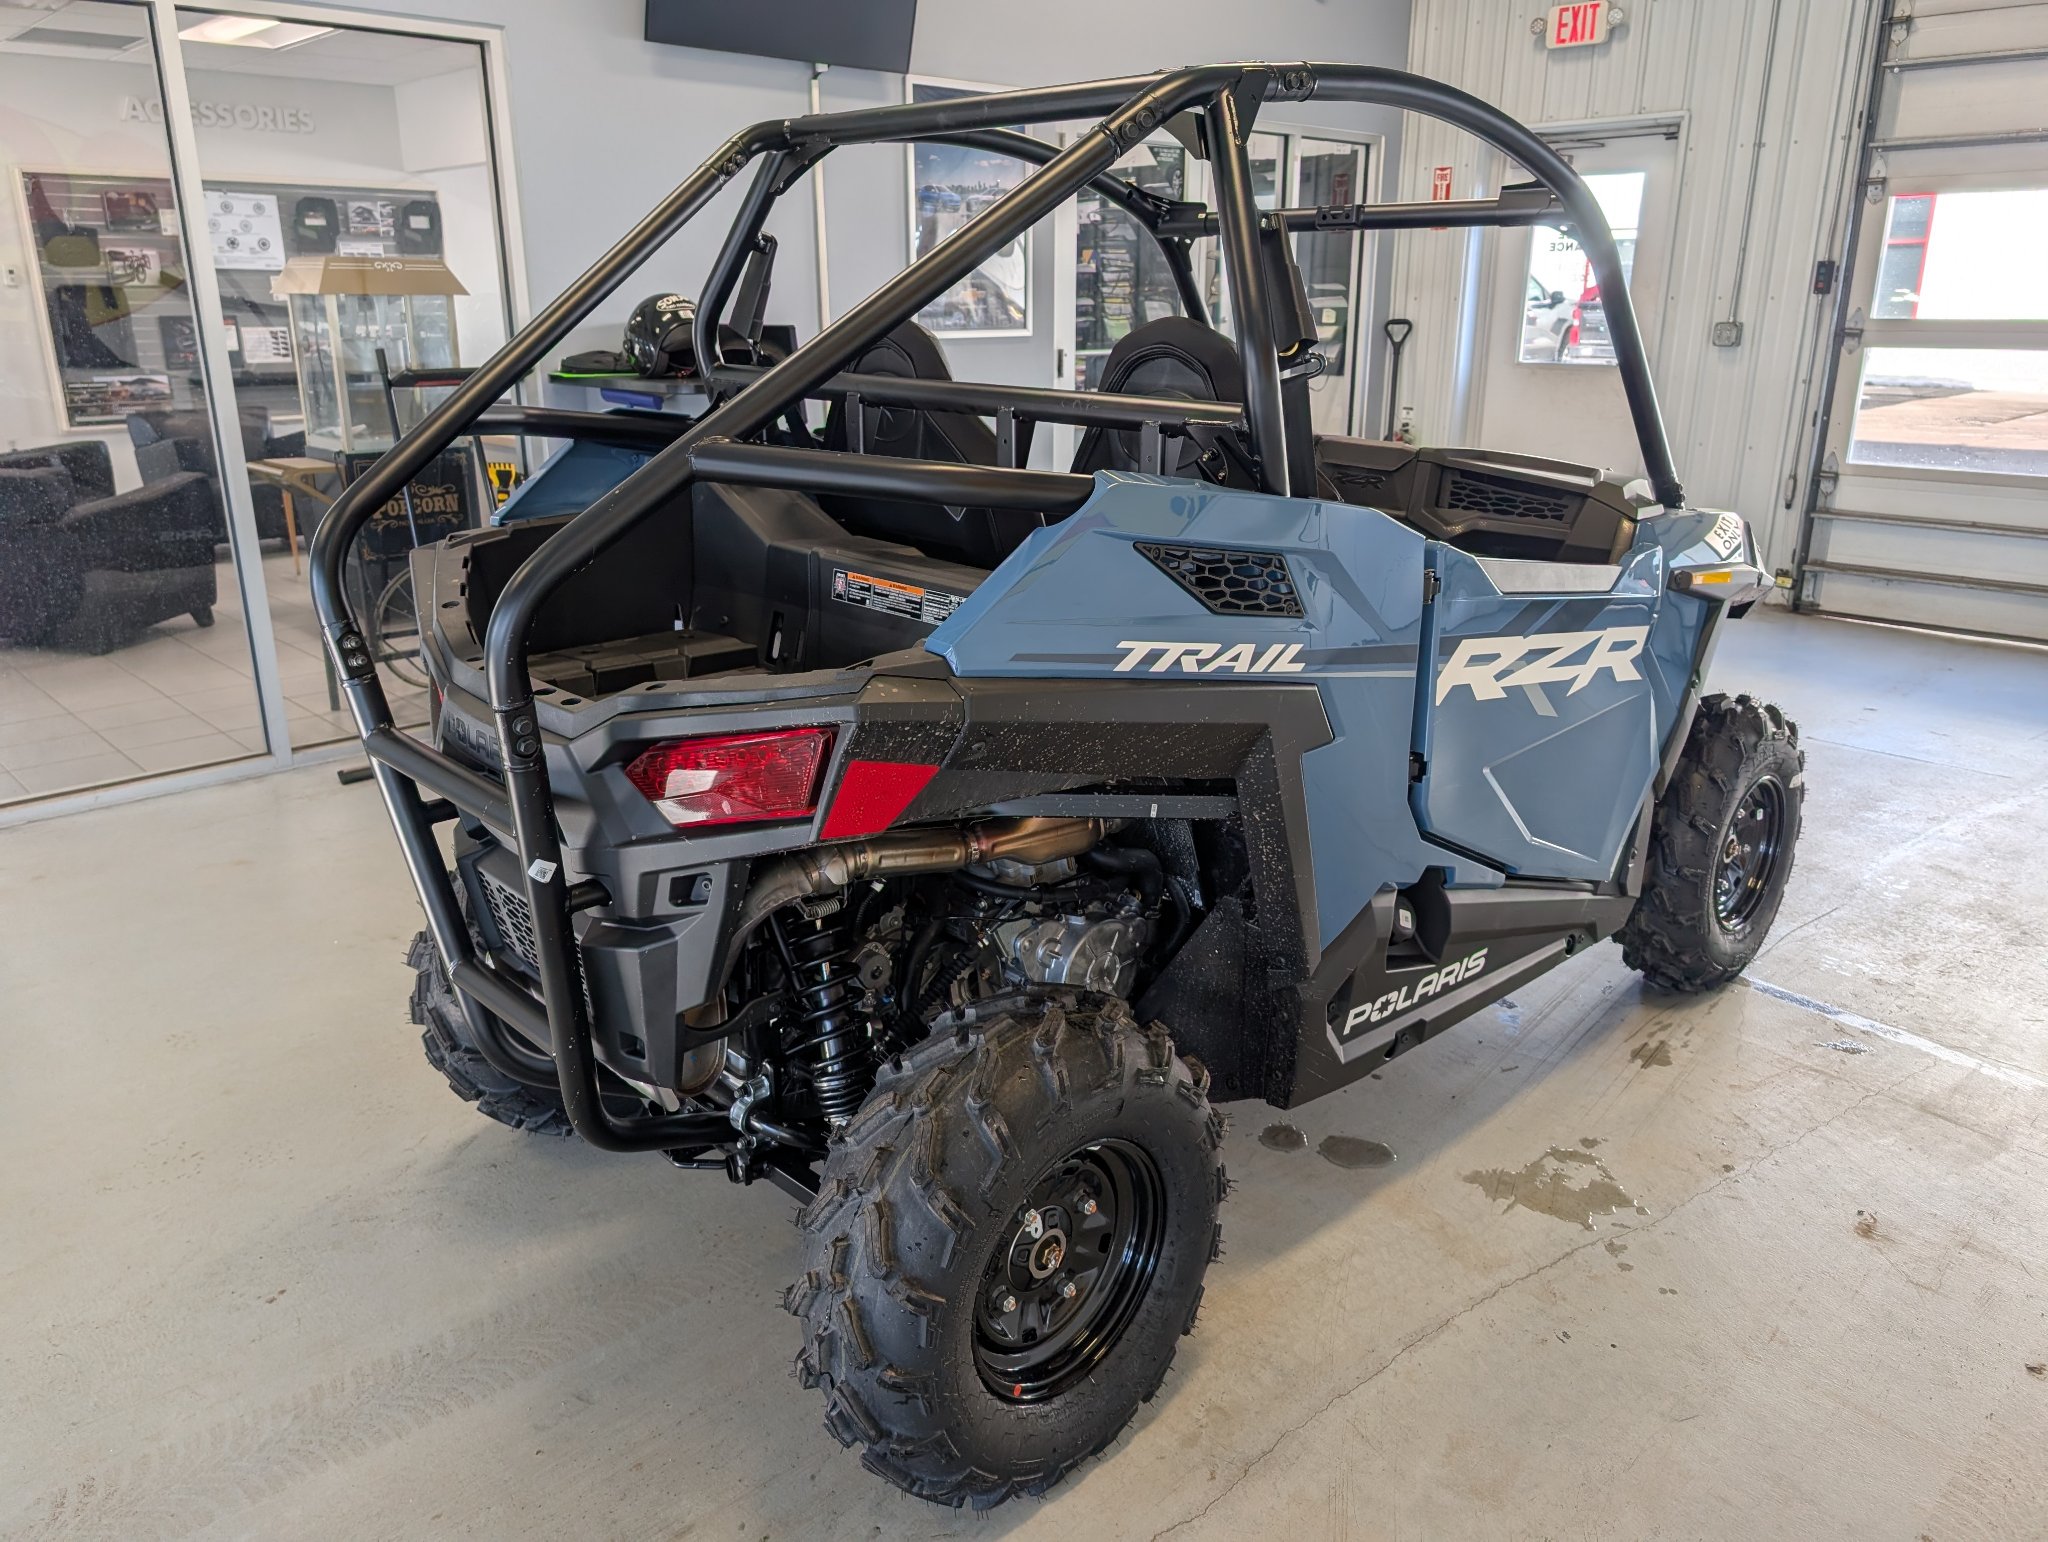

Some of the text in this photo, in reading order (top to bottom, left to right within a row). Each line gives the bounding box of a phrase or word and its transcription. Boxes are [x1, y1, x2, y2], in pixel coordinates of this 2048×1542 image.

[1556, 3, 1600, 45] EXIT
[121, 97, 316, 134] ACESSORIES
[1714, 516, 1734, 540] EXIT
[1723, 521, 1741, 550] ONLY
[1113, 641, 1306, 672] TRAIL
[1435, 626, 1650, 706] RZR
[445, 709, 499, 761] POLAR
[1343, 948, 1488, 1036] POLARIS
